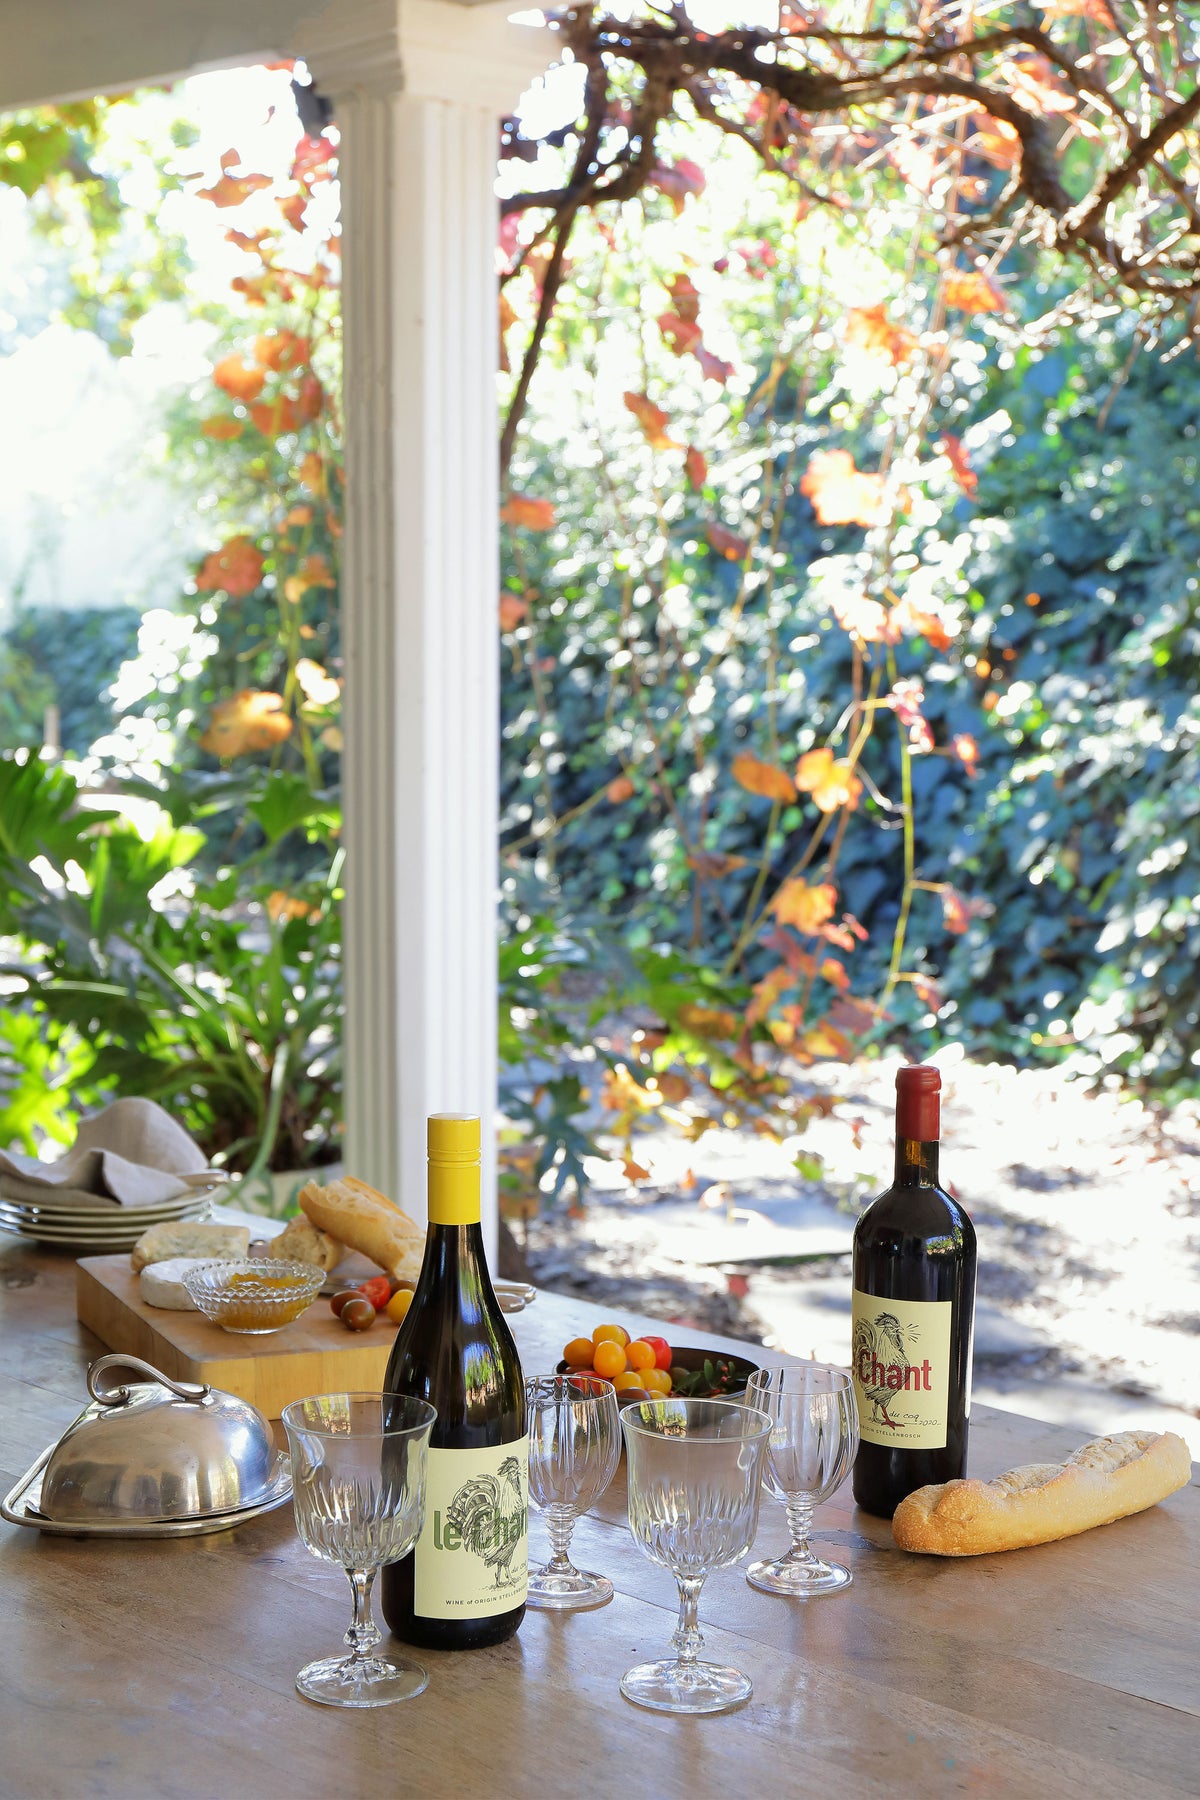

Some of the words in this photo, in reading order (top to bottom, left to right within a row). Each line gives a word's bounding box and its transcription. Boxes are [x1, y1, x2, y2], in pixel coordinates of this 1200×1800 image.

[858, 1348, 932, 1391] Chant
[903, 1413, 920, 1422] coq
[876, 1429, 921, 1438] STELLENBOSCH
[434, 1510, 462, 1550] le
